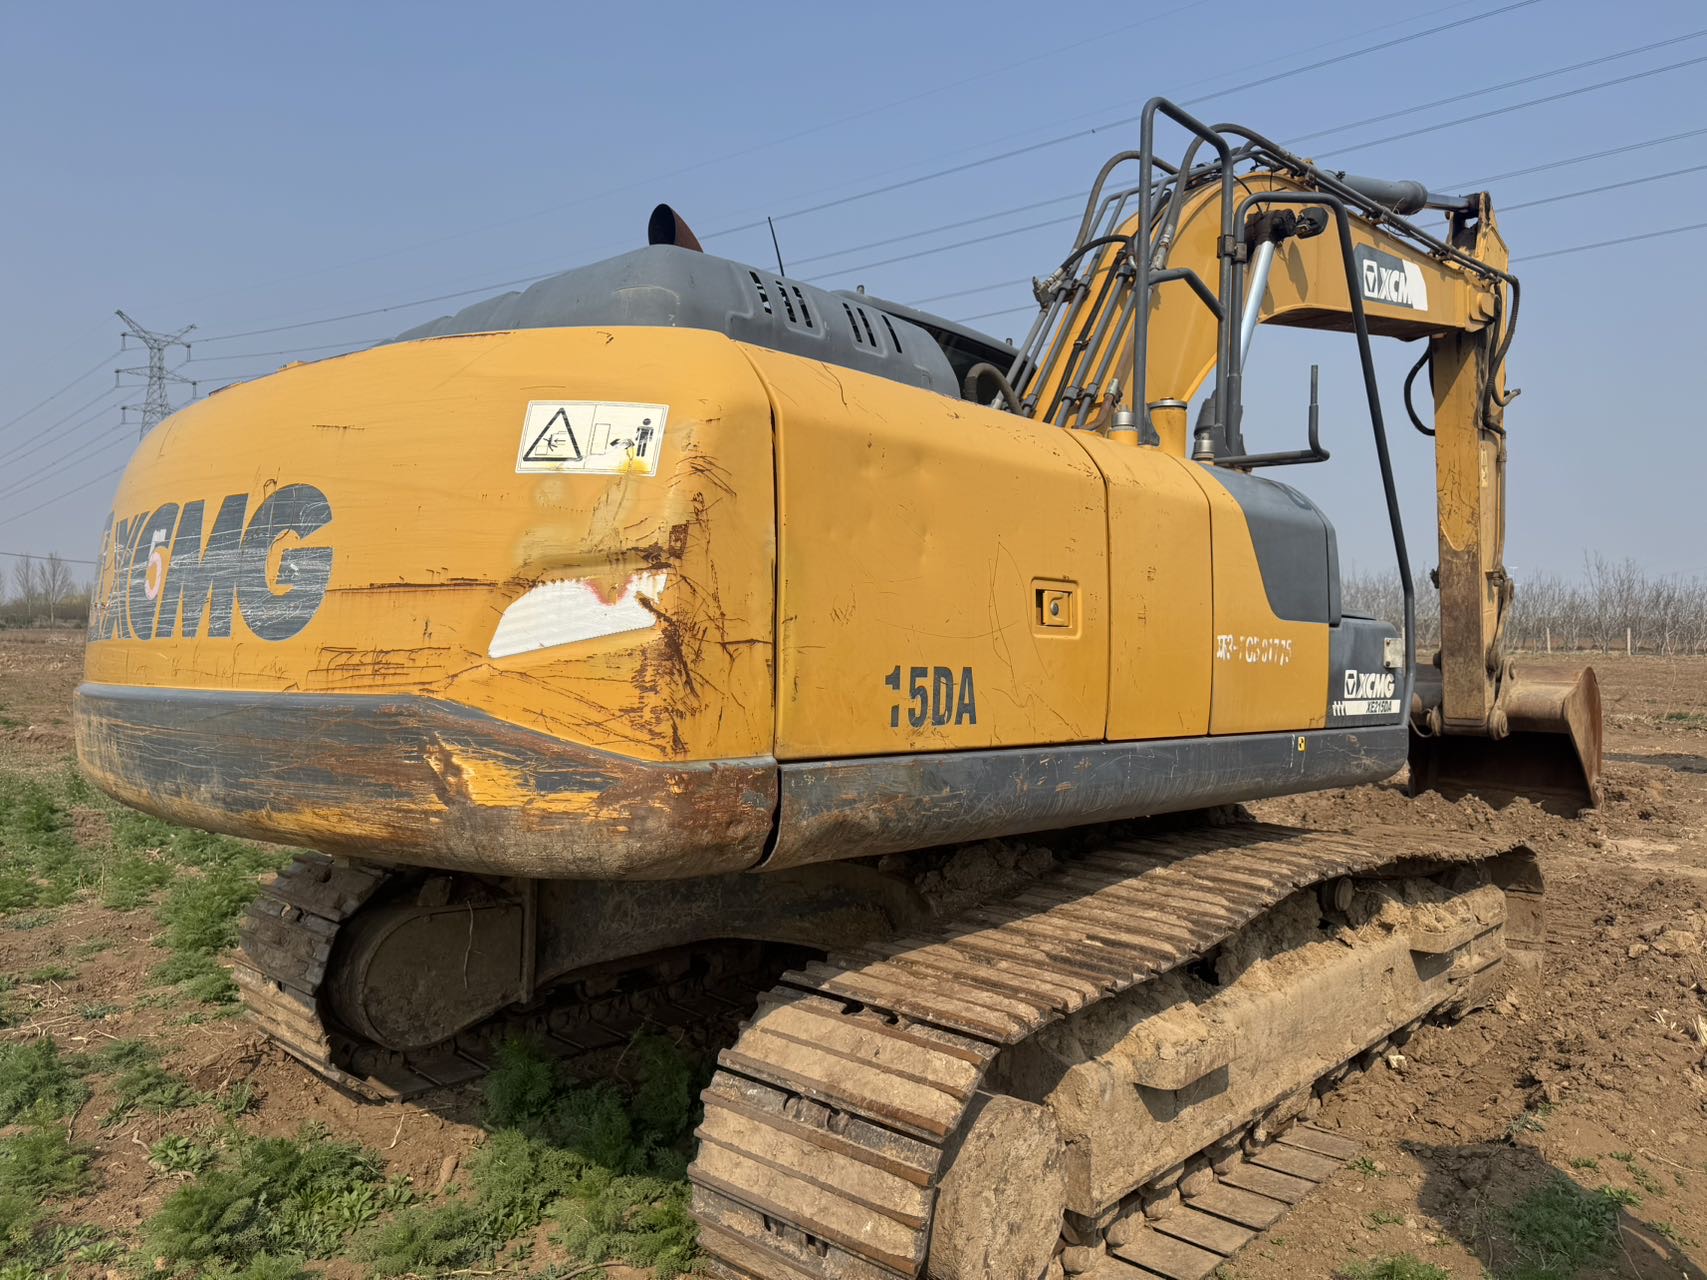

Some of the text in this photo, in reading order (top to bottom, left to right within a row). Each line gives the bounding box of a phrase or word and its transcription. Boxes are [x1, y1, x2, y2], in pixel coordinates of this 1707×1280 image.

[101, 483, 333, 641] XCMG
[885, 665, 976, 728] 15DA
[1355, 673, 1395, 698] XCMG
